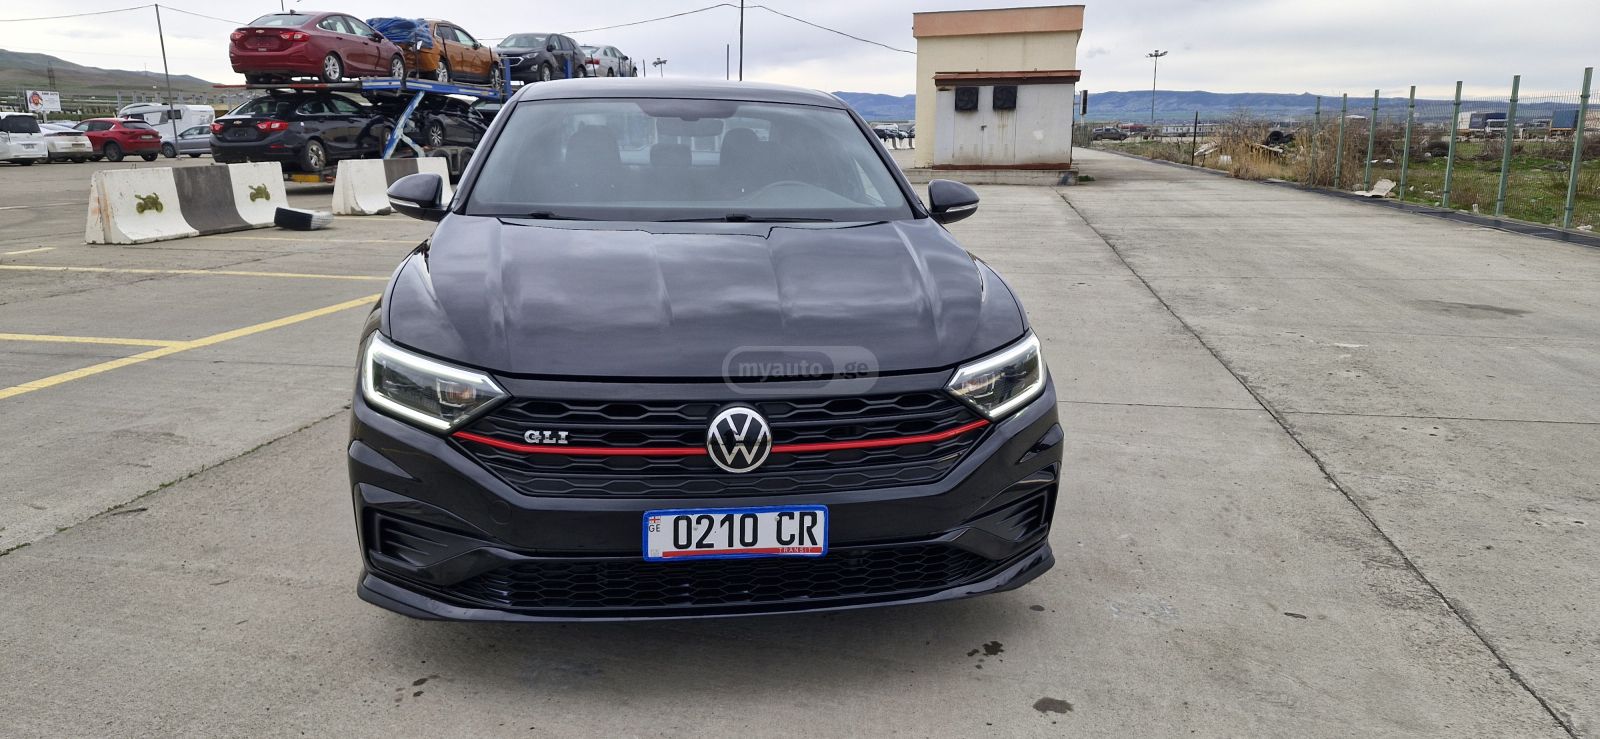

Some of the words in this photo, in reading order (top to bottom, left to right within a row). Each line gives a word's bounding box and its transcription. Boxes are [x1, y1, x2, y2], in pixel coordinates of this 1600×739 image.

[524, 429, 569, 444] GLI
[708, 408, 770, 471] VW
[648, 523, 661, 533] GE
[673, 513, 758, 550] 0210
[776, 511, 818, 546] CR
